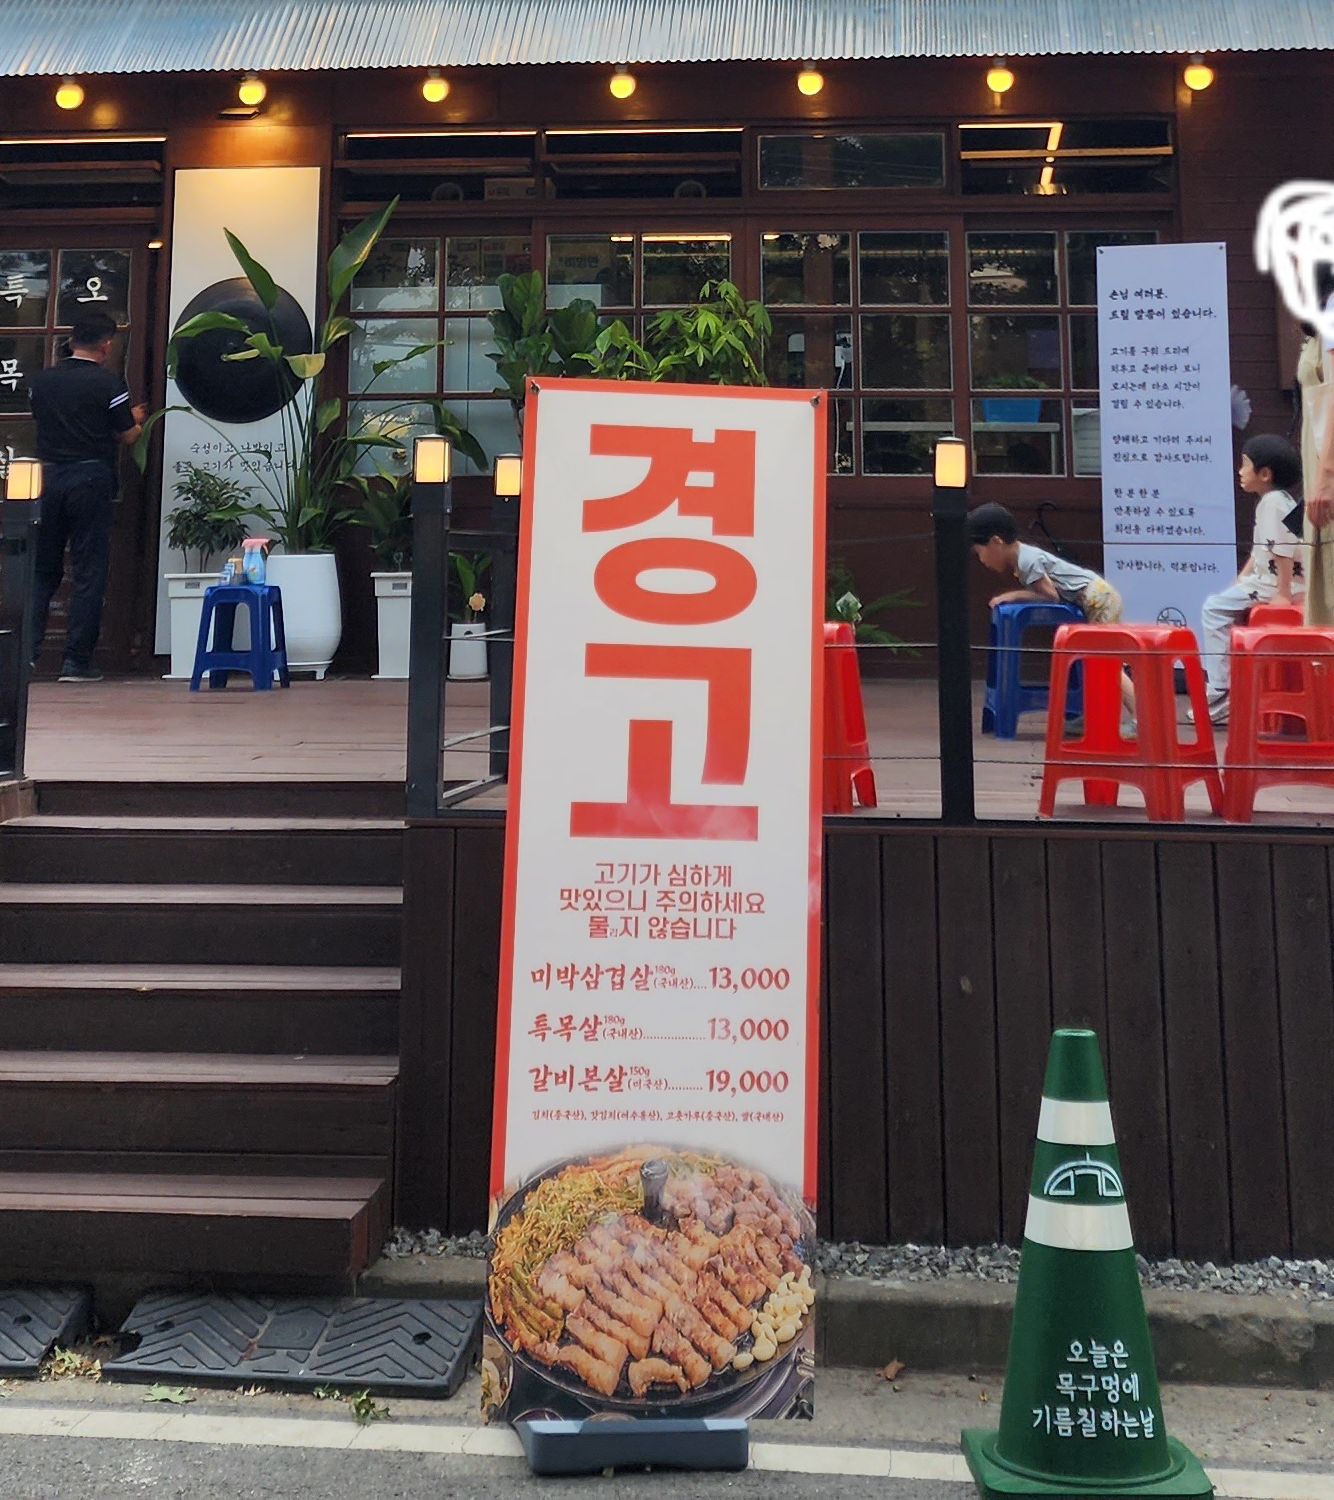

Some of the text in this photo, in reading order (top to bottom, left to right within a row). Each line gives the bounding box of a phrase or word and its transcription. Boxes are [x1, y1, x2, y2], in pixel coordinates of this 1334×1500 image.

[1108, 288, 1129, 300] 손님
[1170, 307, 1217, 320] 있습니다.
[570, 423, 759, 842] 경고
[594, 862, 733, 888] 고기가 심하게
[559, 888, 766, 914] 맛있으니 주의하세요
[648, 916, 737, 941] 않습니다
[530, 962, 654, 991] 미박삼겹살
[708, 966, 790, 994] 13,000
[527, 1013, 603, 1043] 특목살
[707, 1017, 790, 1045] 13,000
[528, 1064, 628, 1093] 갈비본살
[705, 1069, 789, 1098] 19,000
[1066, 1338, 1129, 1369] 오늘은
[1055, 1371, 1140, 1404] 목구멍에
[1031, 1404, 1155, 1438] 기름칠하는날
